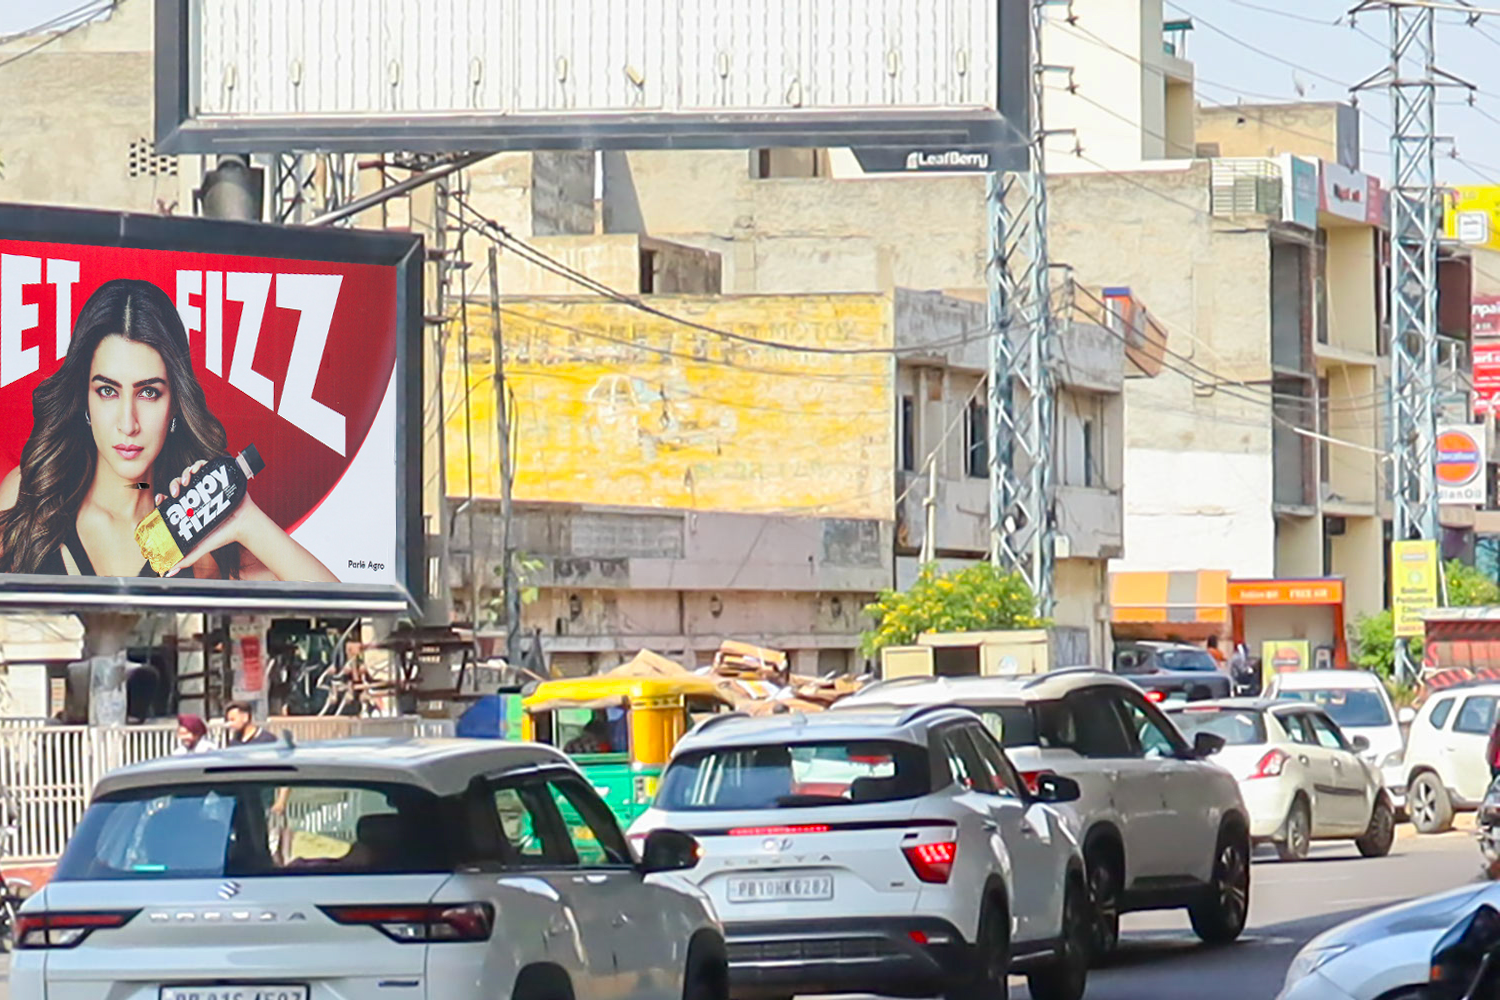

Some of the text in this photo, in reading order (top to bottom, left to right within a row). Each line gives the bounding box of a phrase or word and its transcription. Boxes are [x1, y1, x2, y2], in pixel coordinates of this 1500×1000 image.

[919, 151, 989, 169] LeafBerry
[176, 269, 347, 459] FIZZ
[165, 464, 230, 526] appy
[177, 490, 232, 542] fizz
[367, 560, 385, 571] Agro
